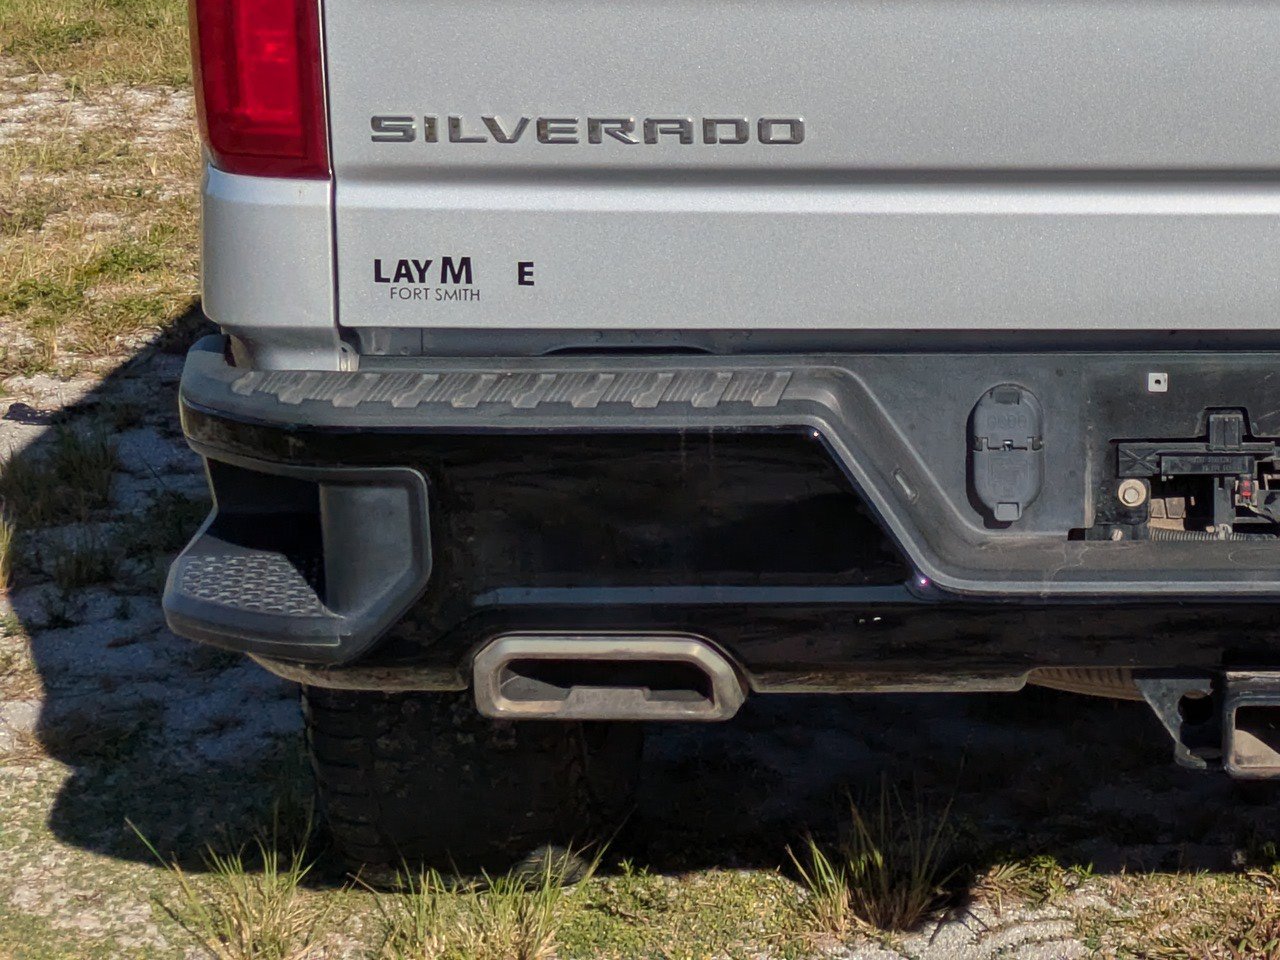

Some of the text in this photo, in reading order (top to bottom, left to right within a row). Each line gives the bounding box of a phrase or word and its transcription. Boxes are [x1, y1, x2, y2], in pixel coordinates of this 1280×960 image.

[369, 114, 807, 145] SILVERADO
[389, 286, 482, 302] FORT SMITH
